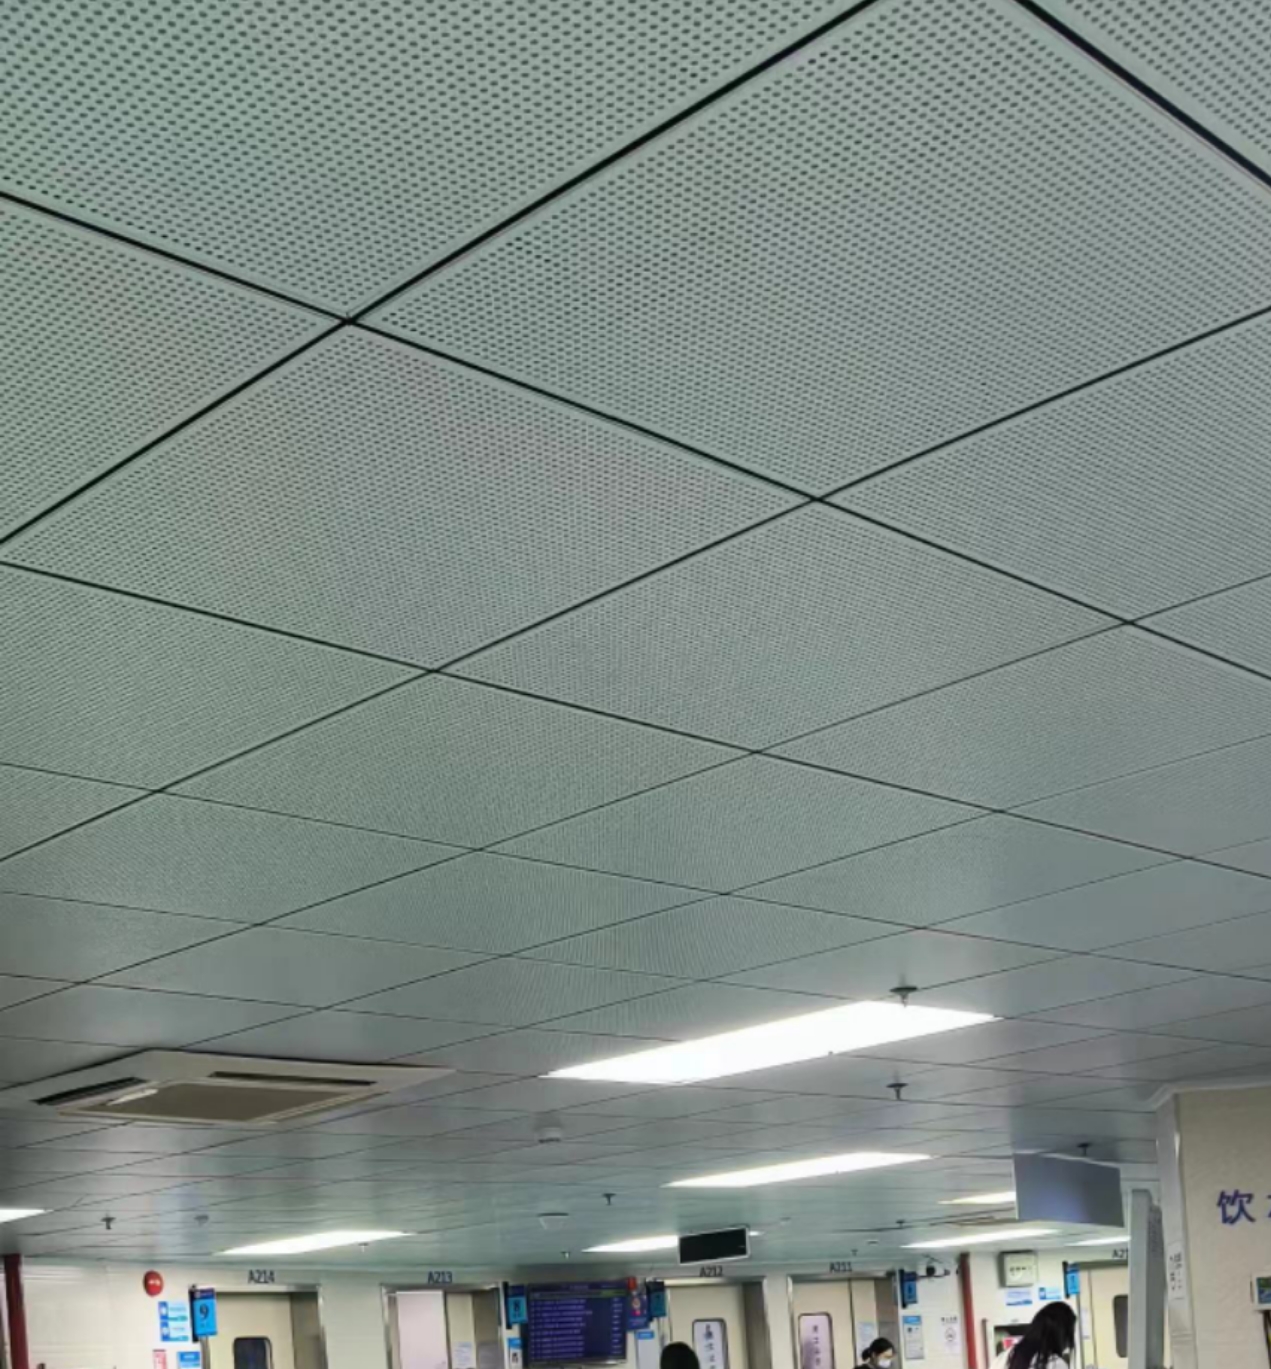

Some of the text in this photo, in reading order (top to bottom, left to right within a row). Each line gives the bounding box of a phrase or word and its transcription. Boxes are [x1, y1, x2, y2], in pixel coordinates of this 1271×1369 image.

[1216, 1189, 1271, 1225] 饮
[700, 1264, 722, 1278] A212
[830, 1261, 852, 1273] A211
[248, 1269, 275, 1284] A214
[428, 1270, 453, 1284] A213
[199, 1303, 210, 1320] 9
